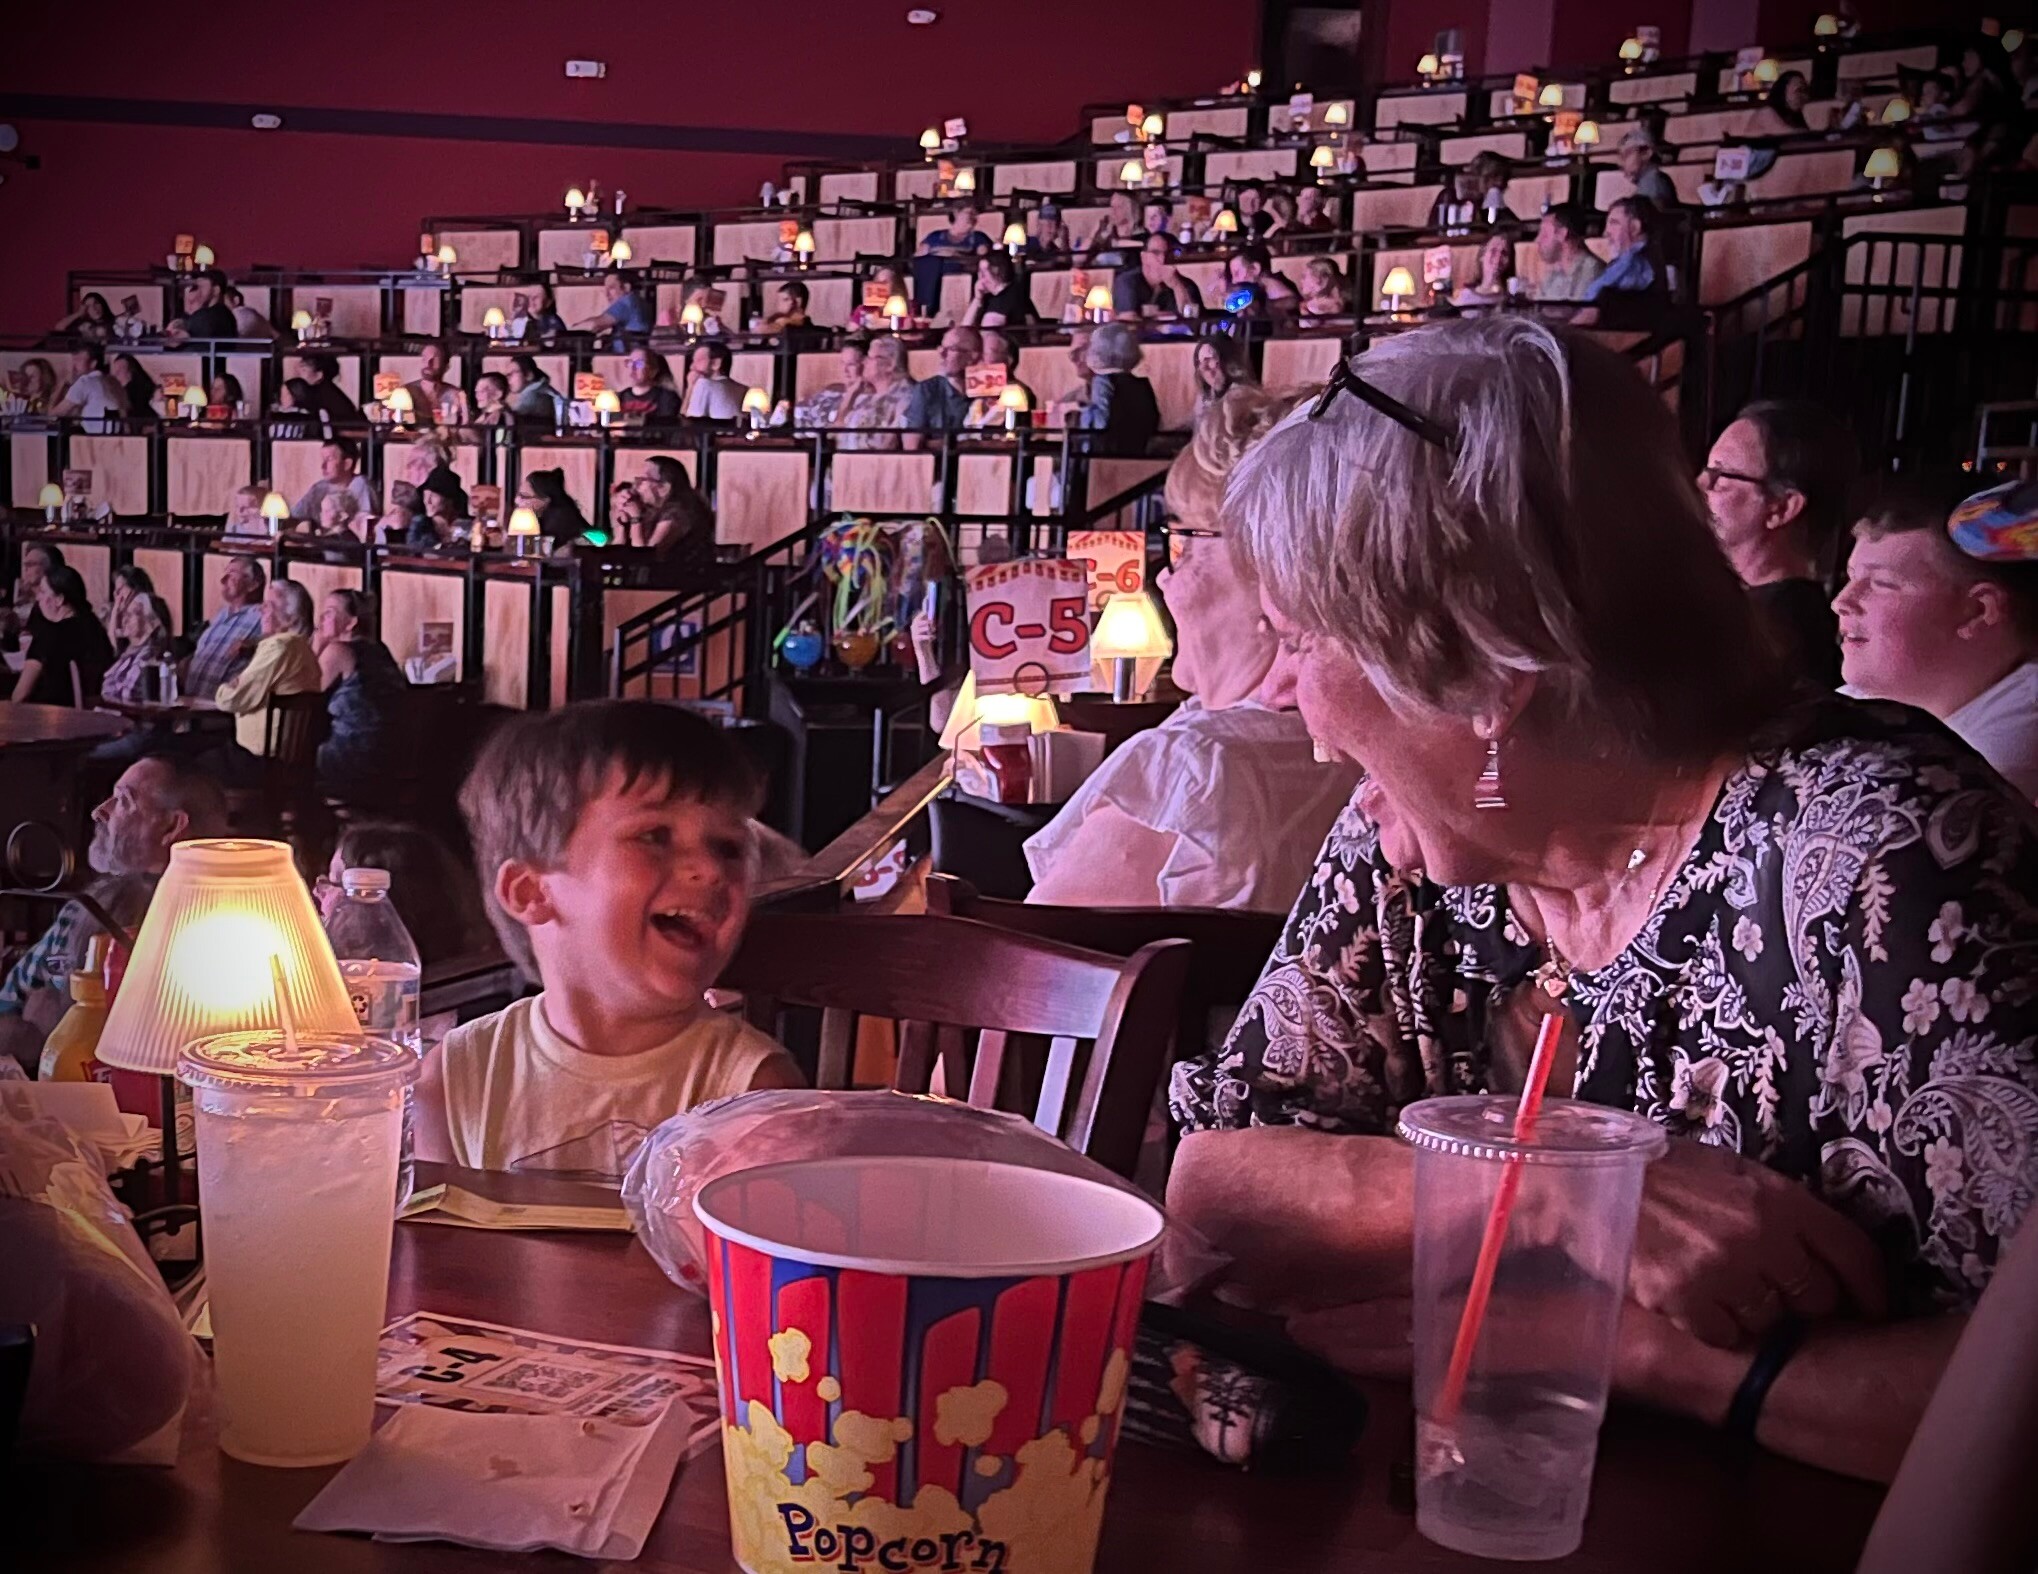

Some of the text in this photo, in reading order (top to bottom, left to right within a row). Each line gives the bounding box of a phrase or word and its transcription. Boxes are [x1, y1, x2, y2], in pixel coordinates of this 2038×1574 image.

[969, 596, 1089, 660] C-5
[414, 1346, 502, 1384] C-4
[776, 1502, 1008, 1574] Popcorn
